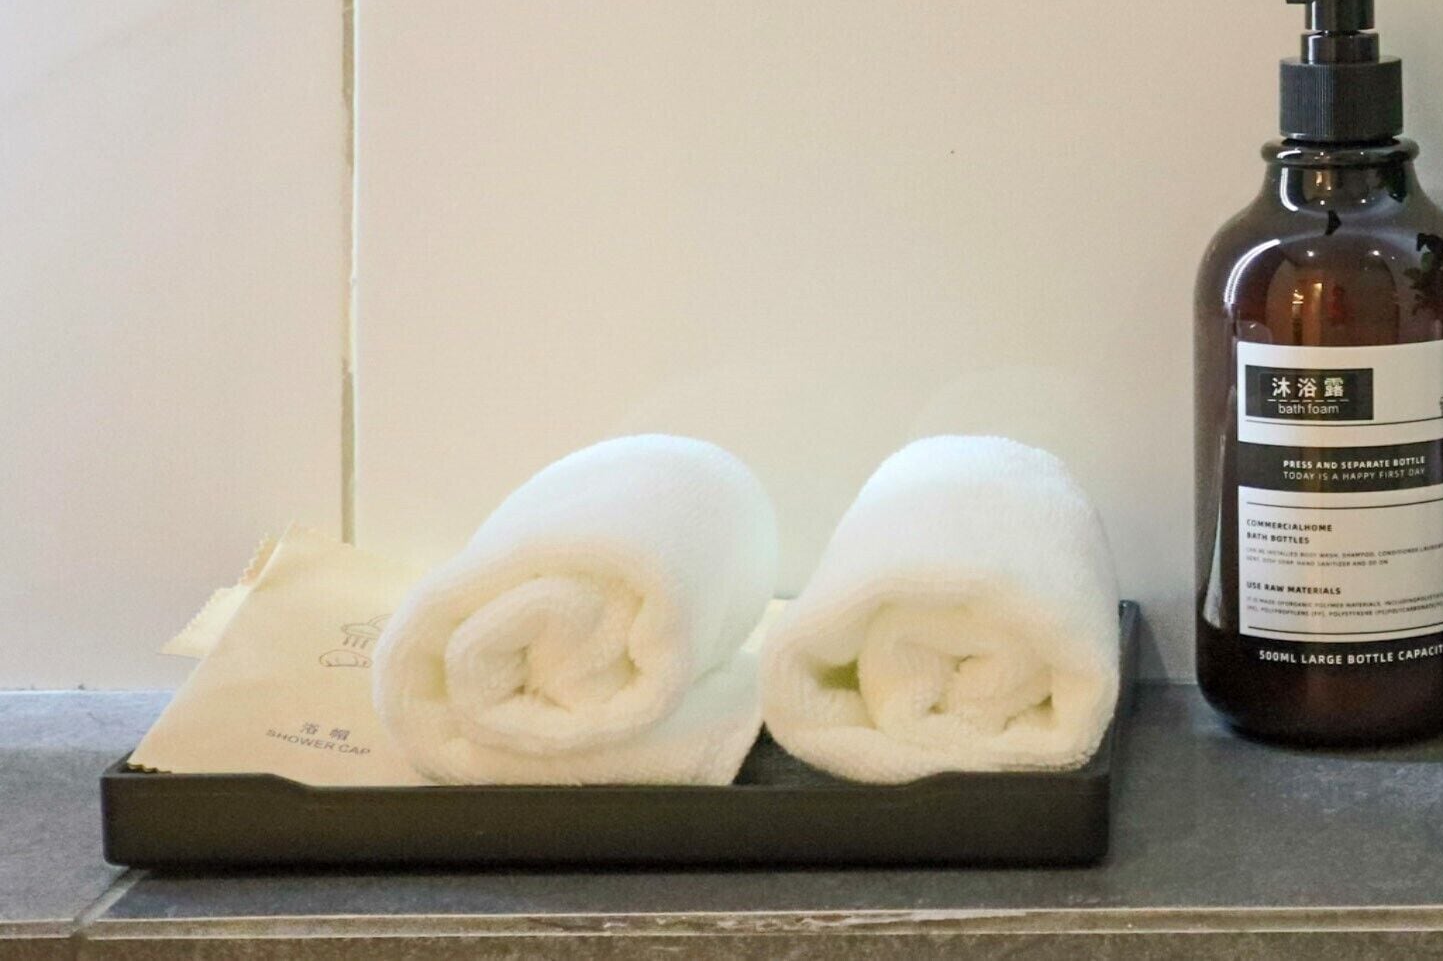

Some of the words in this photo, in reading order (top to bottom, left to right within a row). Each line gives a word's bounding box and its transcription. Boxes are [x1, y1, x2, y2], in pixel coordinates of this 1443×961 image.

[1271, 376, 1344, 398] 沐浴露
[1278, 402, 1305, 414] bath
[1307, 403, 1340, 415] foam
[1284, 460, 1313, 469] PRESS
[1316, 460, 1338, 469] AND
[1341, 458, 1390, 468] SEPARATE
[1393, 456, 1426, 467] BOTTLE
[1284, 471, 1315, 480] TODAY
[1318, 471, 1328, 480] IS
[1332, 471, 1340, 480] A
[1343, 470, 1375, 480] HAPPY
[1379, 469, 1405, 479] FIRST
[1408, 467, 1426, 477] DAY
[1246, 518, 1333, 532] COMMERCIALHOME
[1246, 532, 1268, 542] BATH
[1270, 534, 1310, 544] BOTTLES
[1246, 581, 1262, 591] USE
[1264, 583, 1285, 593] RAW
[1287, 585, 1341, 595] MATERIALS
[1259, 650, 1297, 664] 500ML
[1301, 653, 1342, 665] LARGE
[1347, 652, 1394, 665] BOTTLE
[266, 729, 336, 750] SHOWER
[338, 744, 371, 755] CAP
